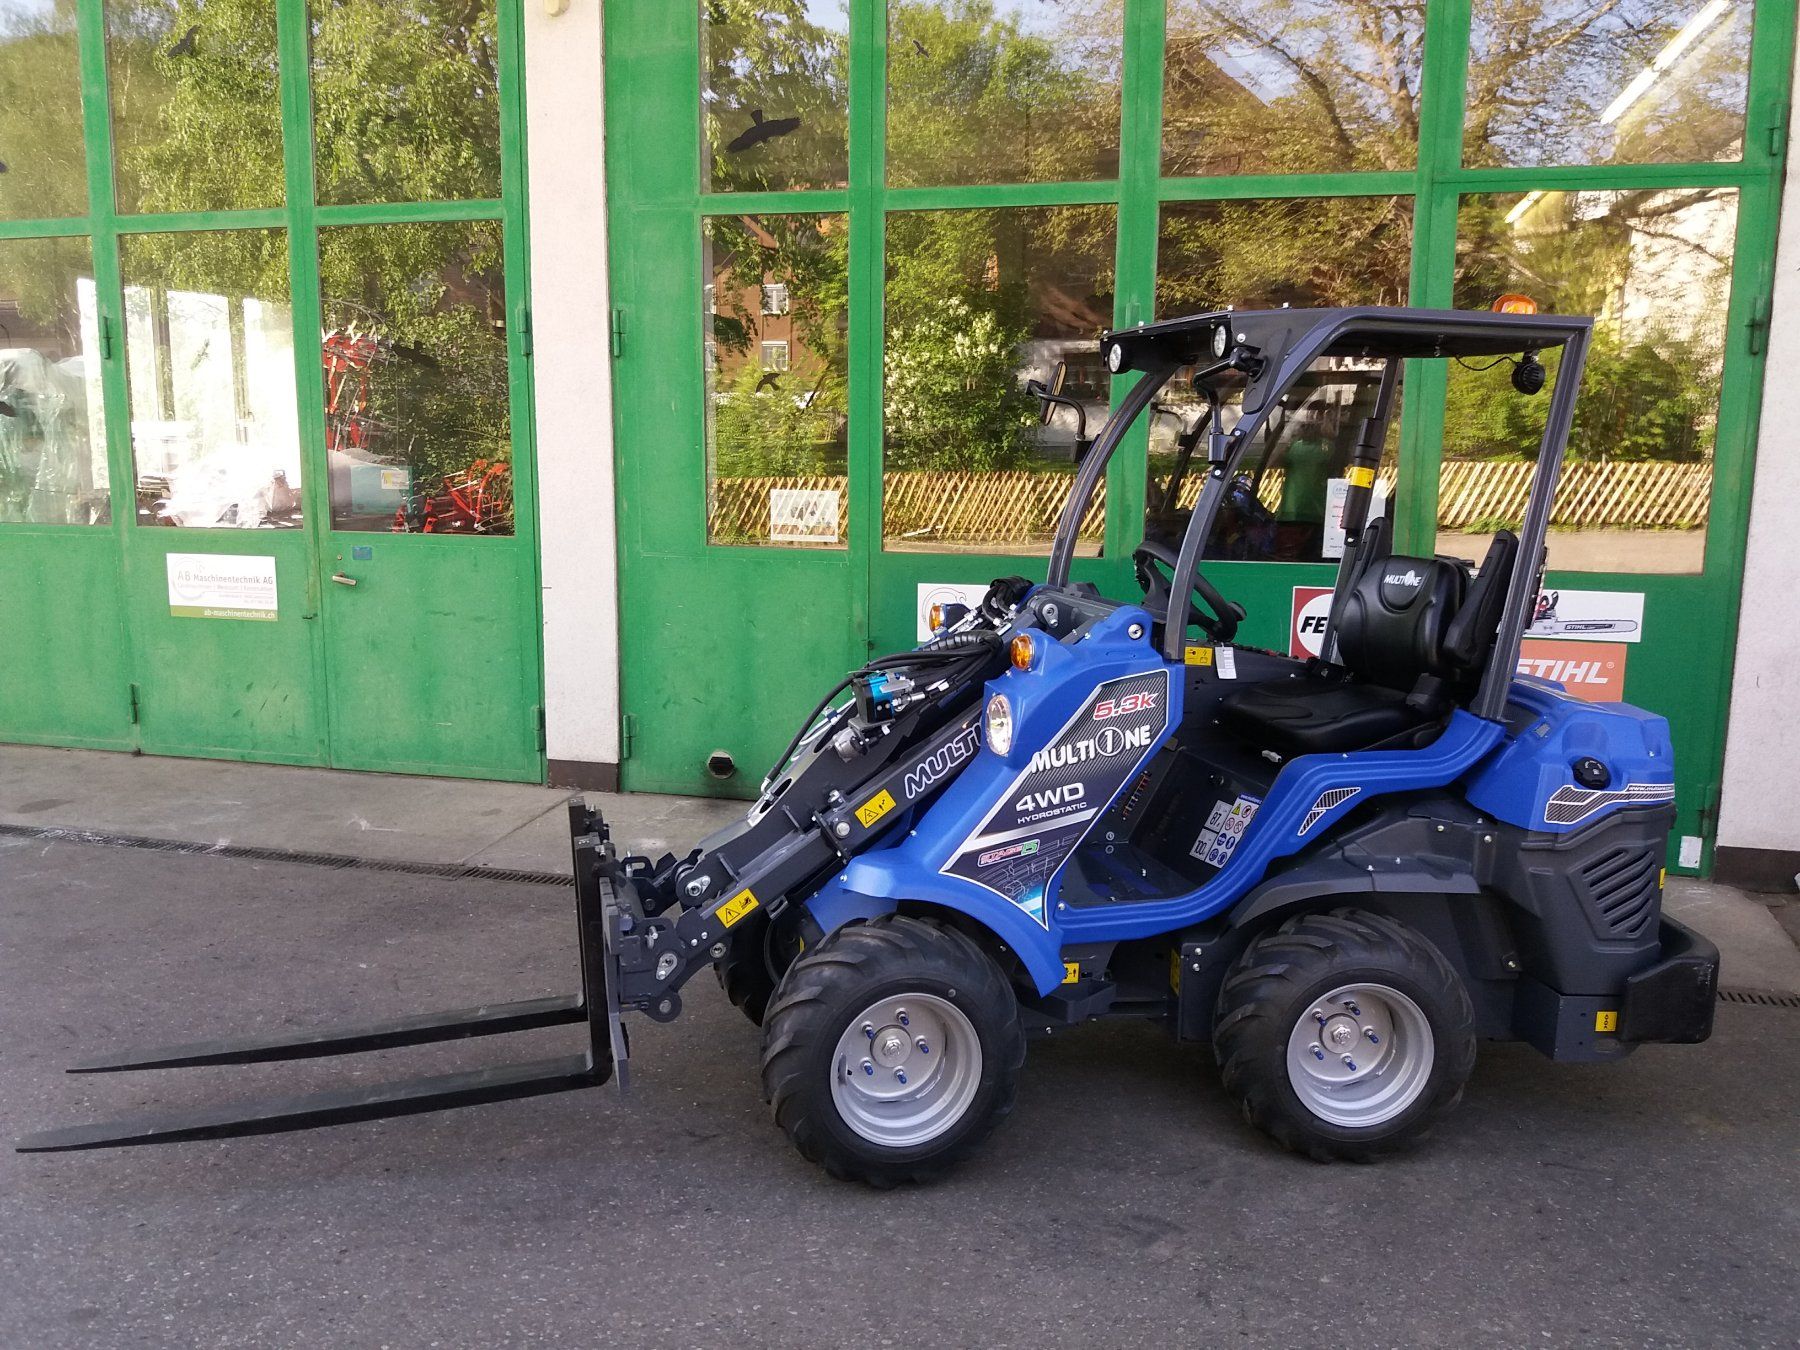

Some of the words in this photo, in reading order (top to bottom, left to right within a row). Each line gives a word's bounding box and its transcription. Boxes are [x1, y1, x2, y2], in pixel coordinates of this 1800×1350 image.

[177, 571, 191, 582] AB
[193, 574, 261, 584] Maschinentechnik
[262, 576, 273, 585] AG
[204, 608, 275, 619] ab-maschinentechnik.ch
[1016, 782, 1085, 812] 4WD
[1017, 802, 1087, 824] HYDROSTATIC
